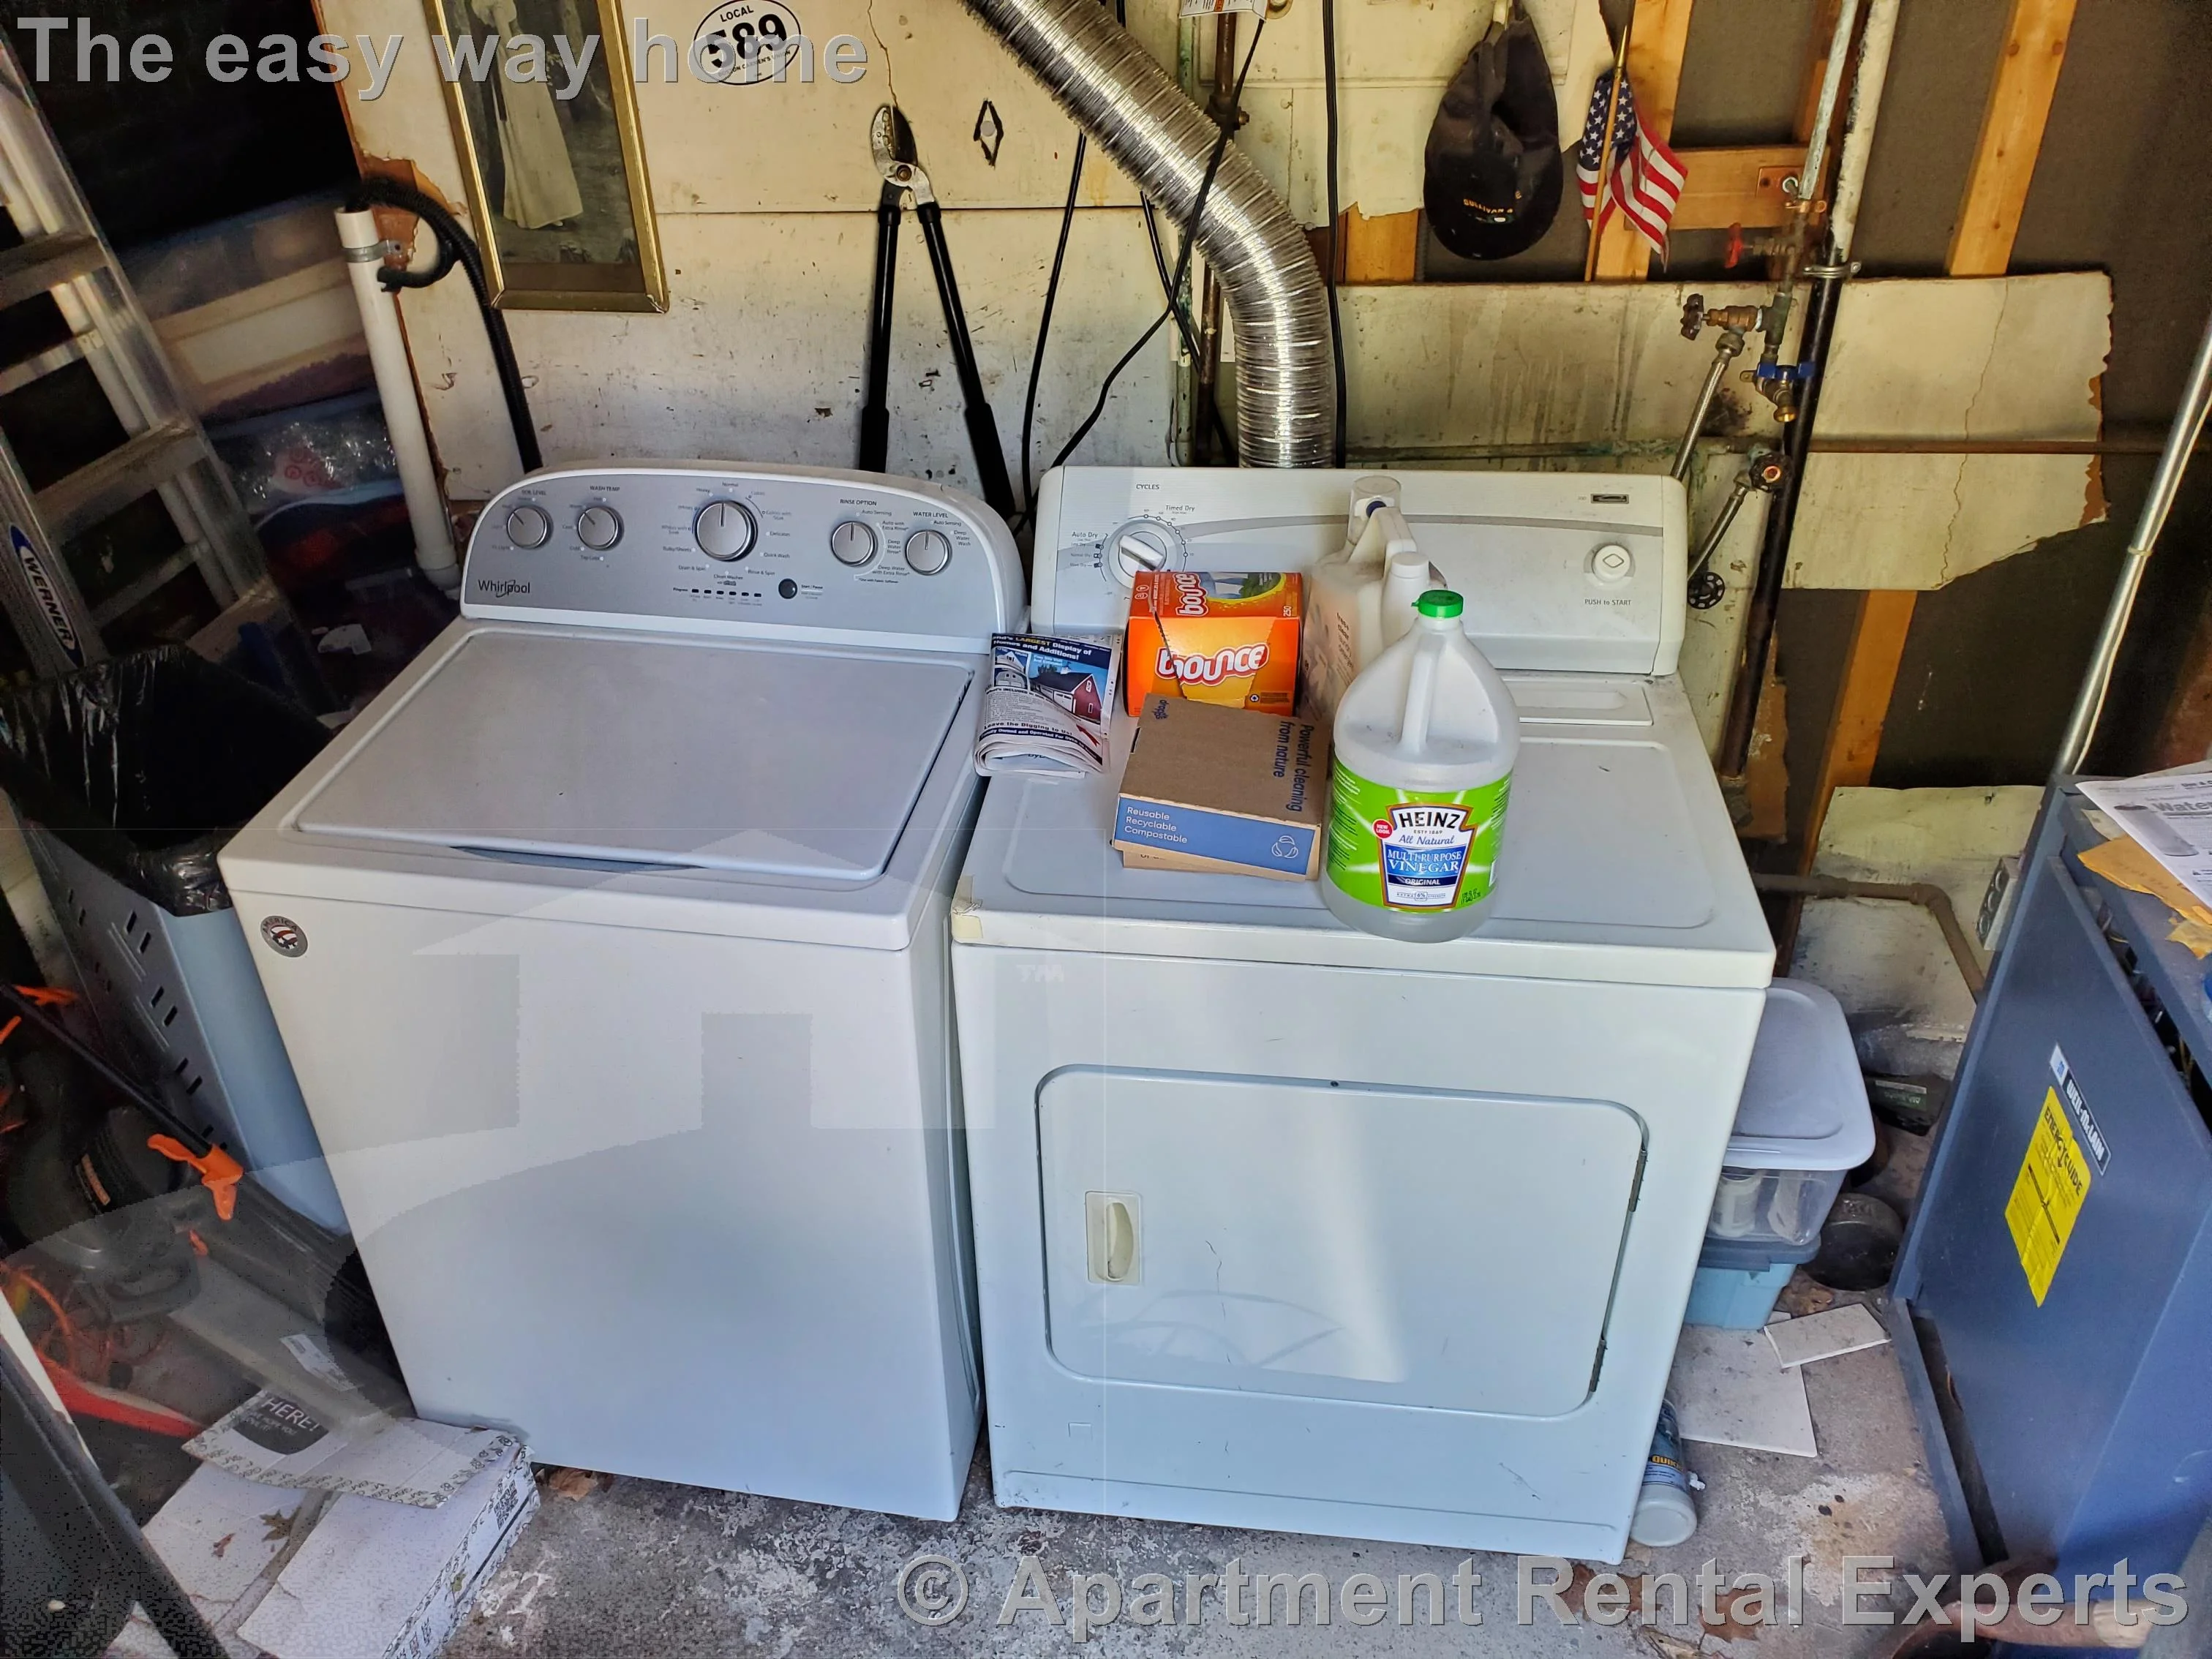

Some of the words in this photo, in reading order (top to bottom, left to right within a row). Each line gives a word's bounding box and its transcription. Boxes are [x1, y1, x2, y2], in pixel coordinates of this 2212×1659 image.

[720, 5, 754, 22] LOCAL
[706, 13, 787, 68] 589
[478, 579, 530, 598] Whirlpool
[23, 556, 75, 645] WERNER
[1282, 605, 1292, 617] 250
[1015, 636, 1050, 647] LARGEST
[1052, 642, 1082, 654] Display
[1039, 646, 1080, 661] Additions!
[1157, 644, 1266, 684] bounce
[1021, 722, 1050, 731] Digging
[1277, 721, 1296, 744] from
[1295, 723, 1315, 767] Powerful
[1273, 745, 1290, 778] nature
[1285, 768, 1310, 812] cleaning
[1126, 806, 1170, 821] Reusable
[1399, 811, 1461, 829] HEINZ
[1126, 816, 1177, 832] Recyclable
[1124, 825, 1188, 843] Compostable
[1399, 835, 1414, 844] All
[1416, 835, 1455, 846] Natural
[1388, 849, 1462, 862] MULTI-PURPOSE
[1388, 859, 1459, 873] VINEGAR
[1404, 878, 1440, 886] ORIGINAL
[261, 1396, 321, 1433] HERE!
